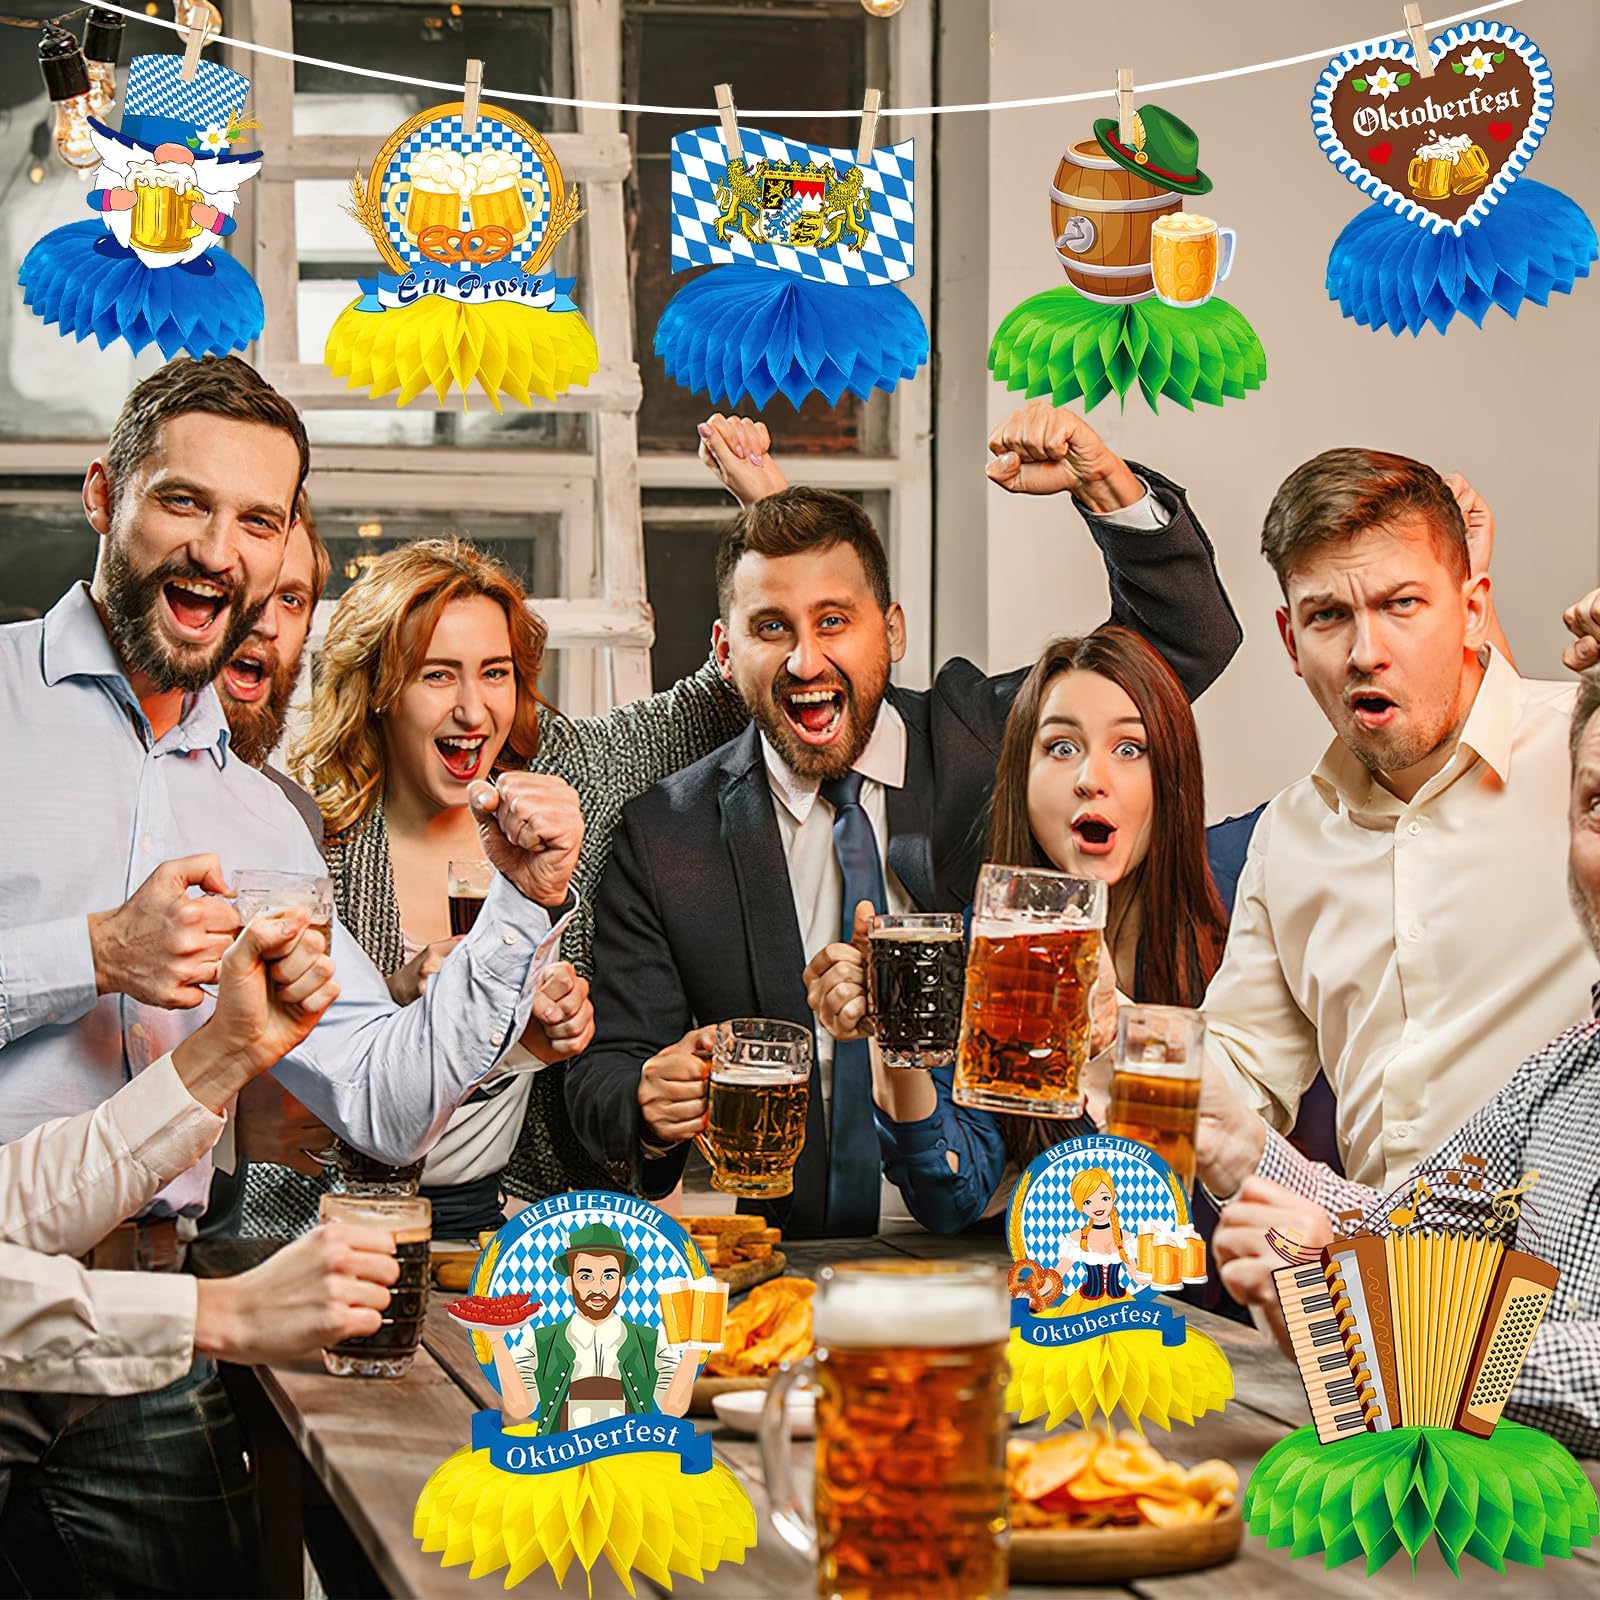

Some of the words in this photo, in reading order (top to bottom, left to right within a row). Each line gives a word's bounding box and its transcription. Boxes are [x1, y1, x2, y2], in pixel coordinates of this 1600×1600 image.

[1353, 87, 1522, 137] Oktoberfest
[397, 270, 446, 303] Ein
[457, 273, 543, 299] Prosit
[1045, 1139, 1083, 1163] BEER
[1087, 1137, 1153, 1164] FESTIVAL
[519, 1196, 570, 1228] BEER
[576, 1194, 664, 1229] FESTIVAL
[1032, 1305, 1162, 1343] Oktoberfest
[506, 1419, 680, 1469] Oktoberfest
